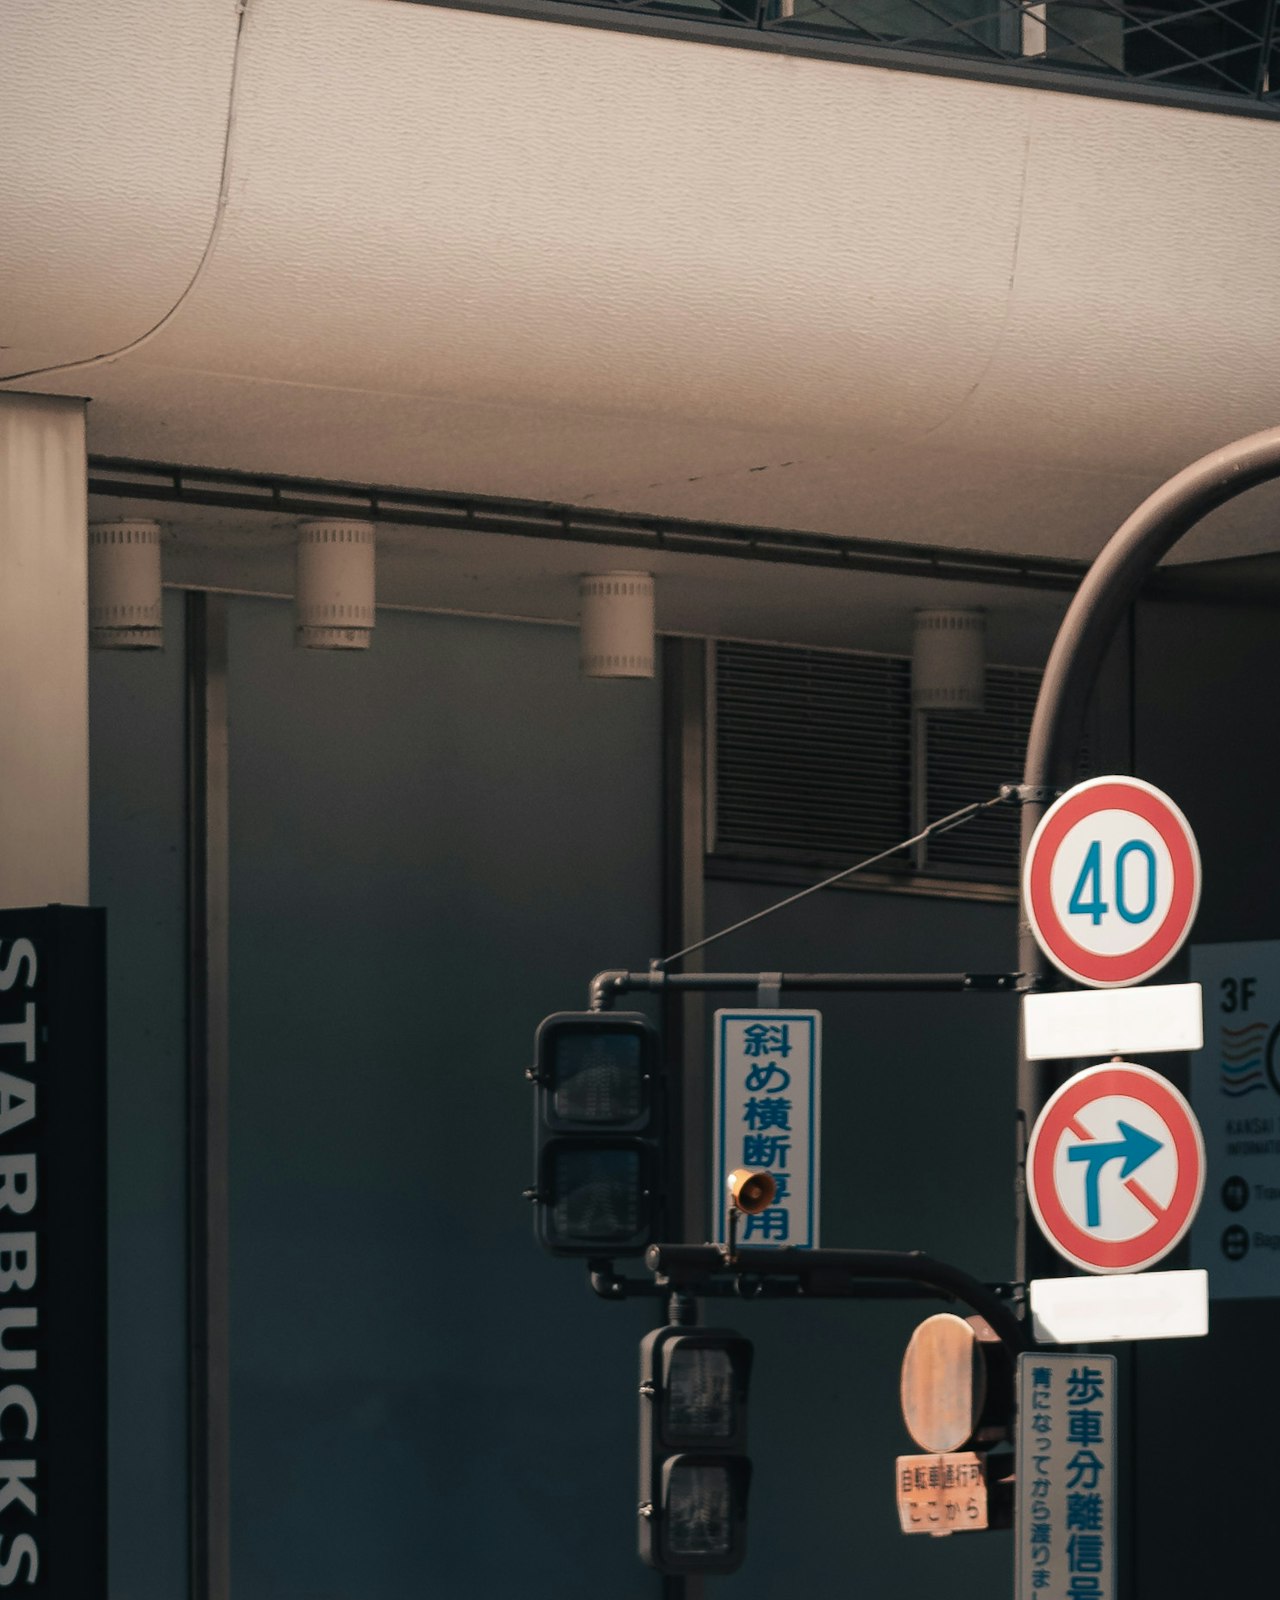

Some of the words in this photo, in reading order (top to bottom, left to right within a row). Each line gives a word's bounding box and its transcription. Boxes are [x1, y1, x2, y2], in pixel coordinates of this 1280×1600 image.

[1068, 840, 1158, 925] 40
[1220, 976, 1257, 1013] 3F
[1226, 1116, 1274, 1136] KANSAI
[0, 937, 39, 1587] STARBUCKS
[910, 1496, 979, 1522] ここから
